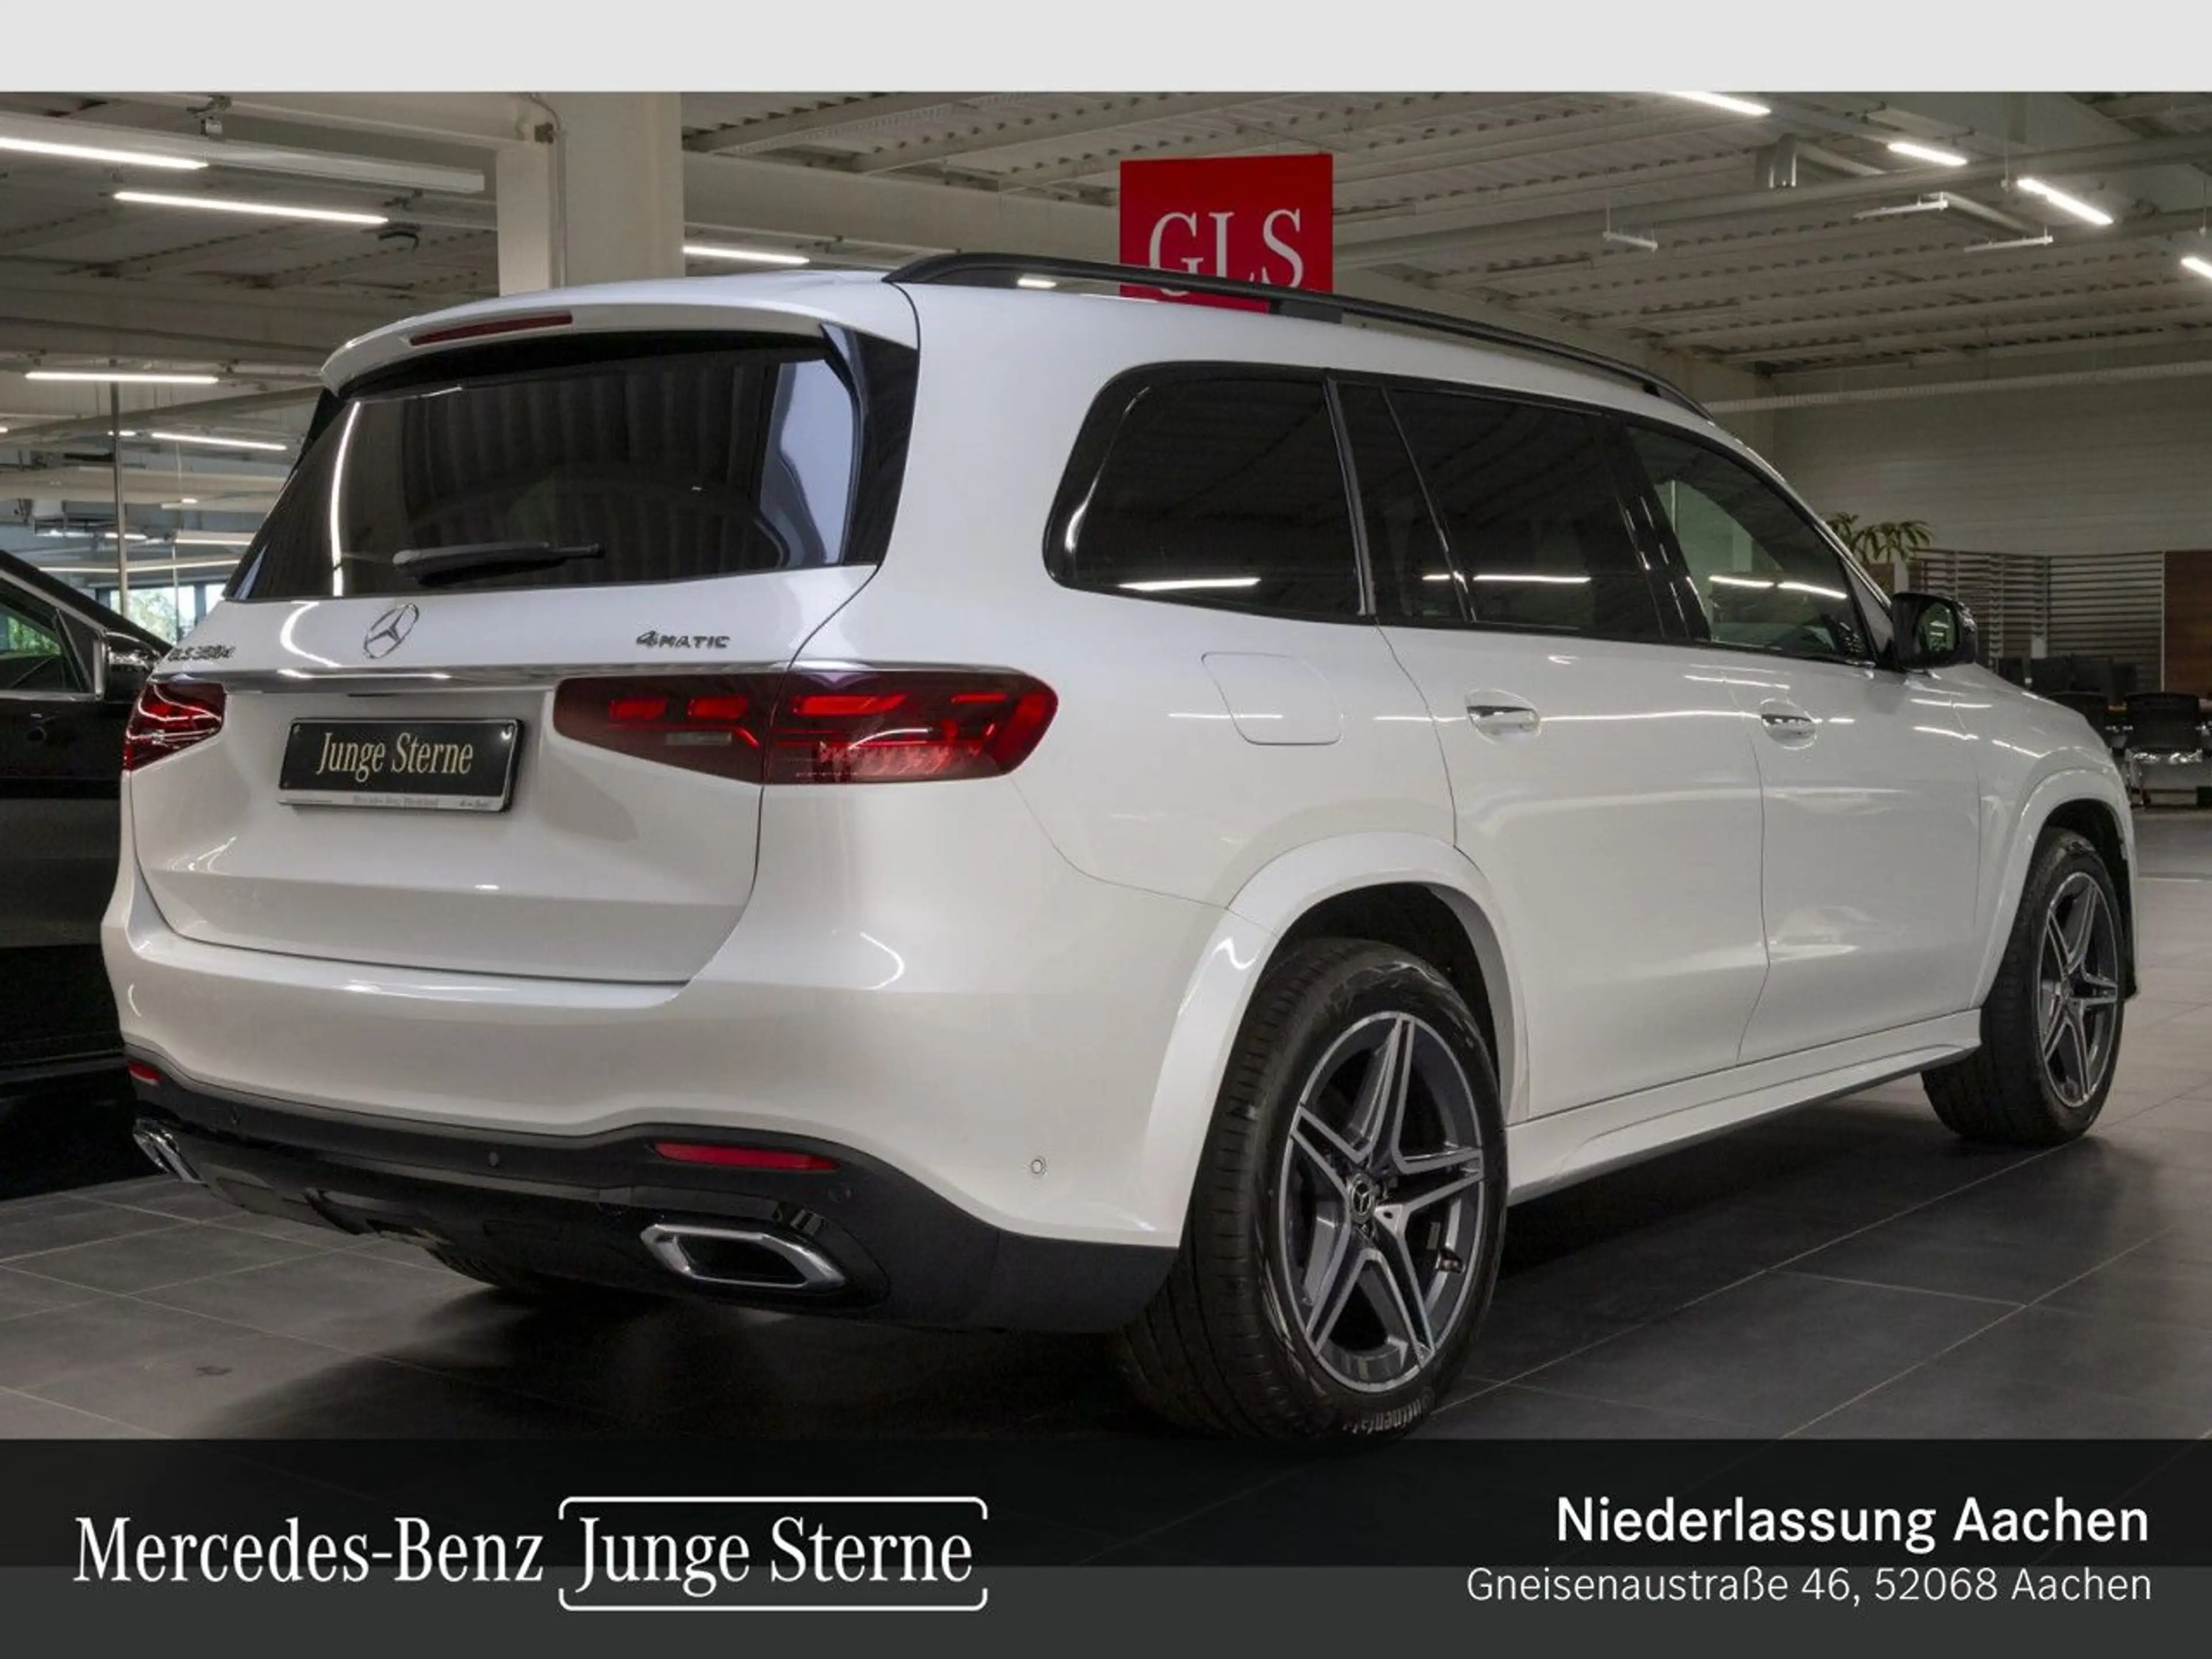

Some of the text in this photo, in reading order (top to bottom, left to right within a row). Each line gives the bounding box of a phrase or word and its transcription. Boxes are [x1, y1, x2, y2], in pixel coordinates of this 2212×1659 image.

[1149, 208, 1304, 297] GLS
[636, 630, 730, 649] 4MATIC
[317, 732, 474, 783] Junge Sterne
